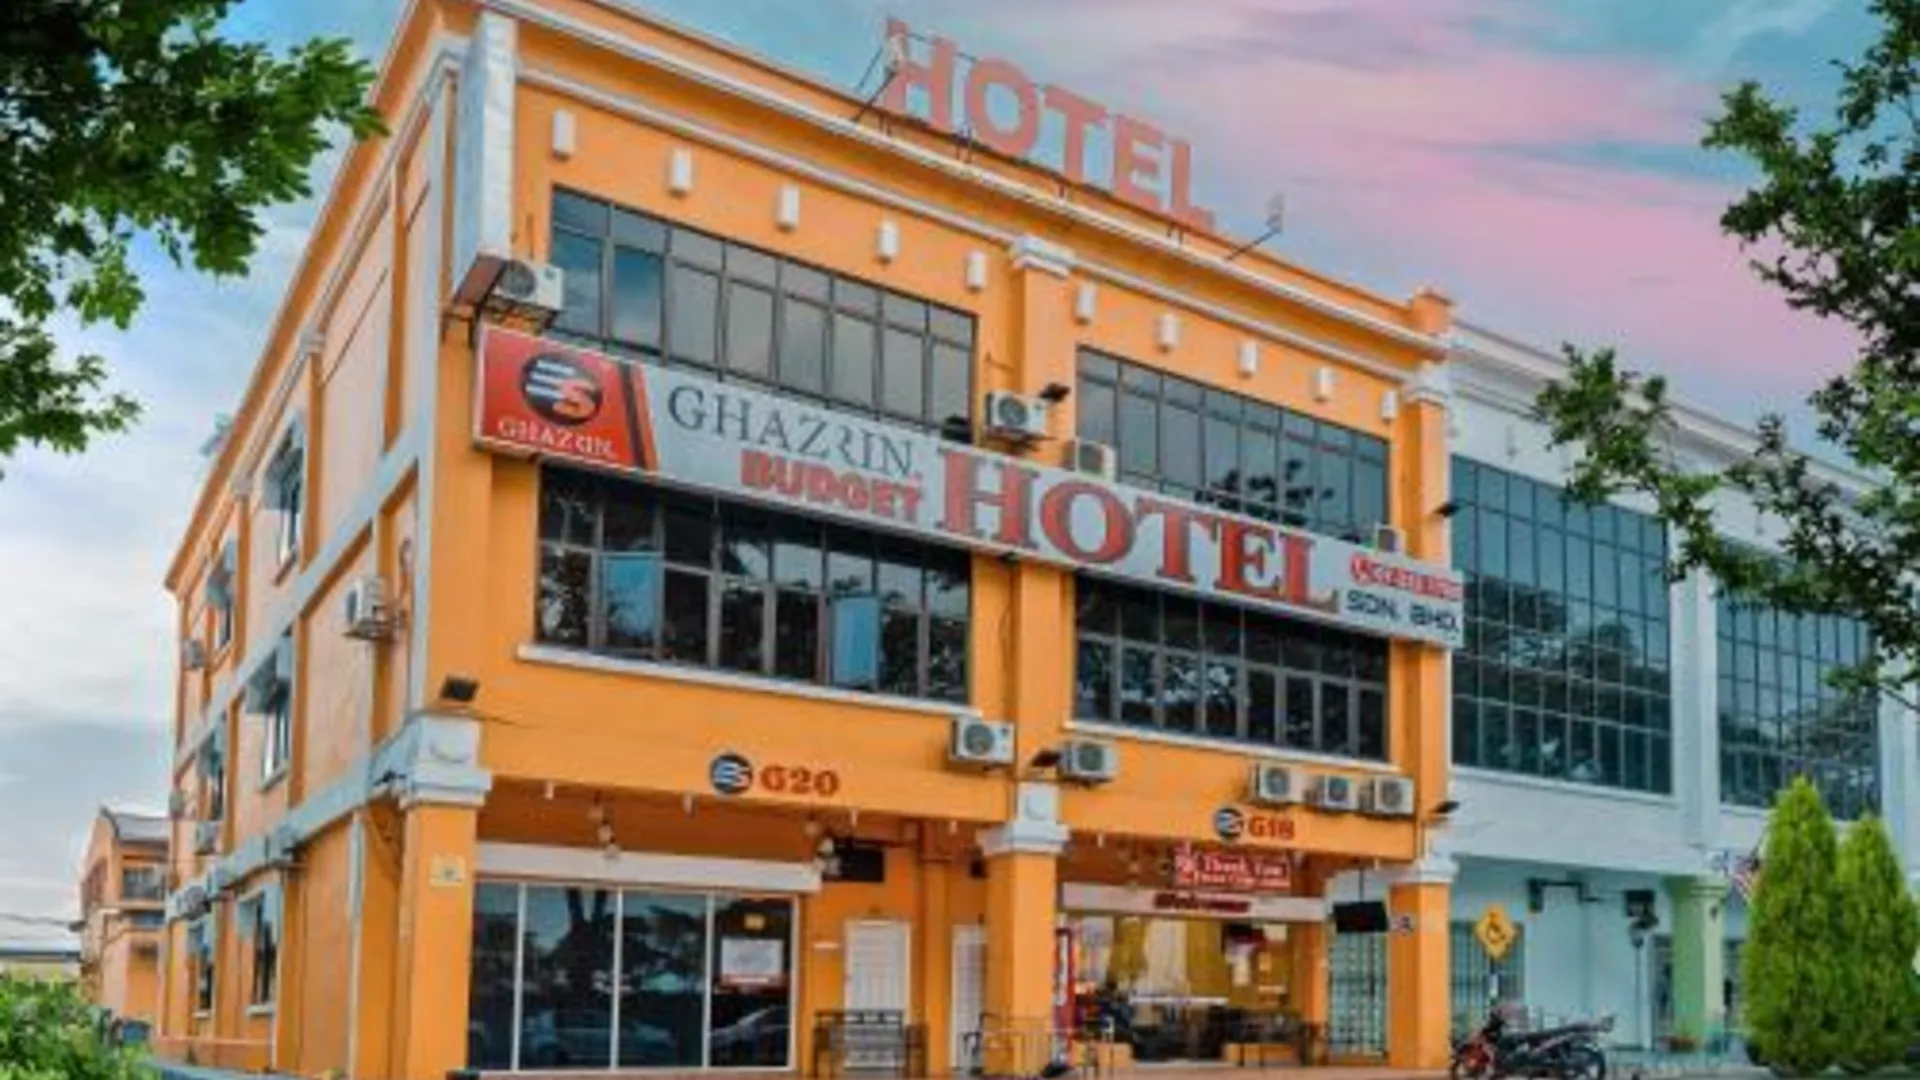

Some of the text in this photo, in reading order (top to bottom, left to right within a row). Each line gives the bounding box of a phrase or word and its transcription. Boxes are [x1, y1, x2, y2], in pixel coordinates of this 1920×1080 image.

[883, 16, 1216, 232] HOTEL
[740, 447, 924, 523] BUDGET
[935, 447, 1340, 615] HOTEL
[760, 763, 840, 798] G20
